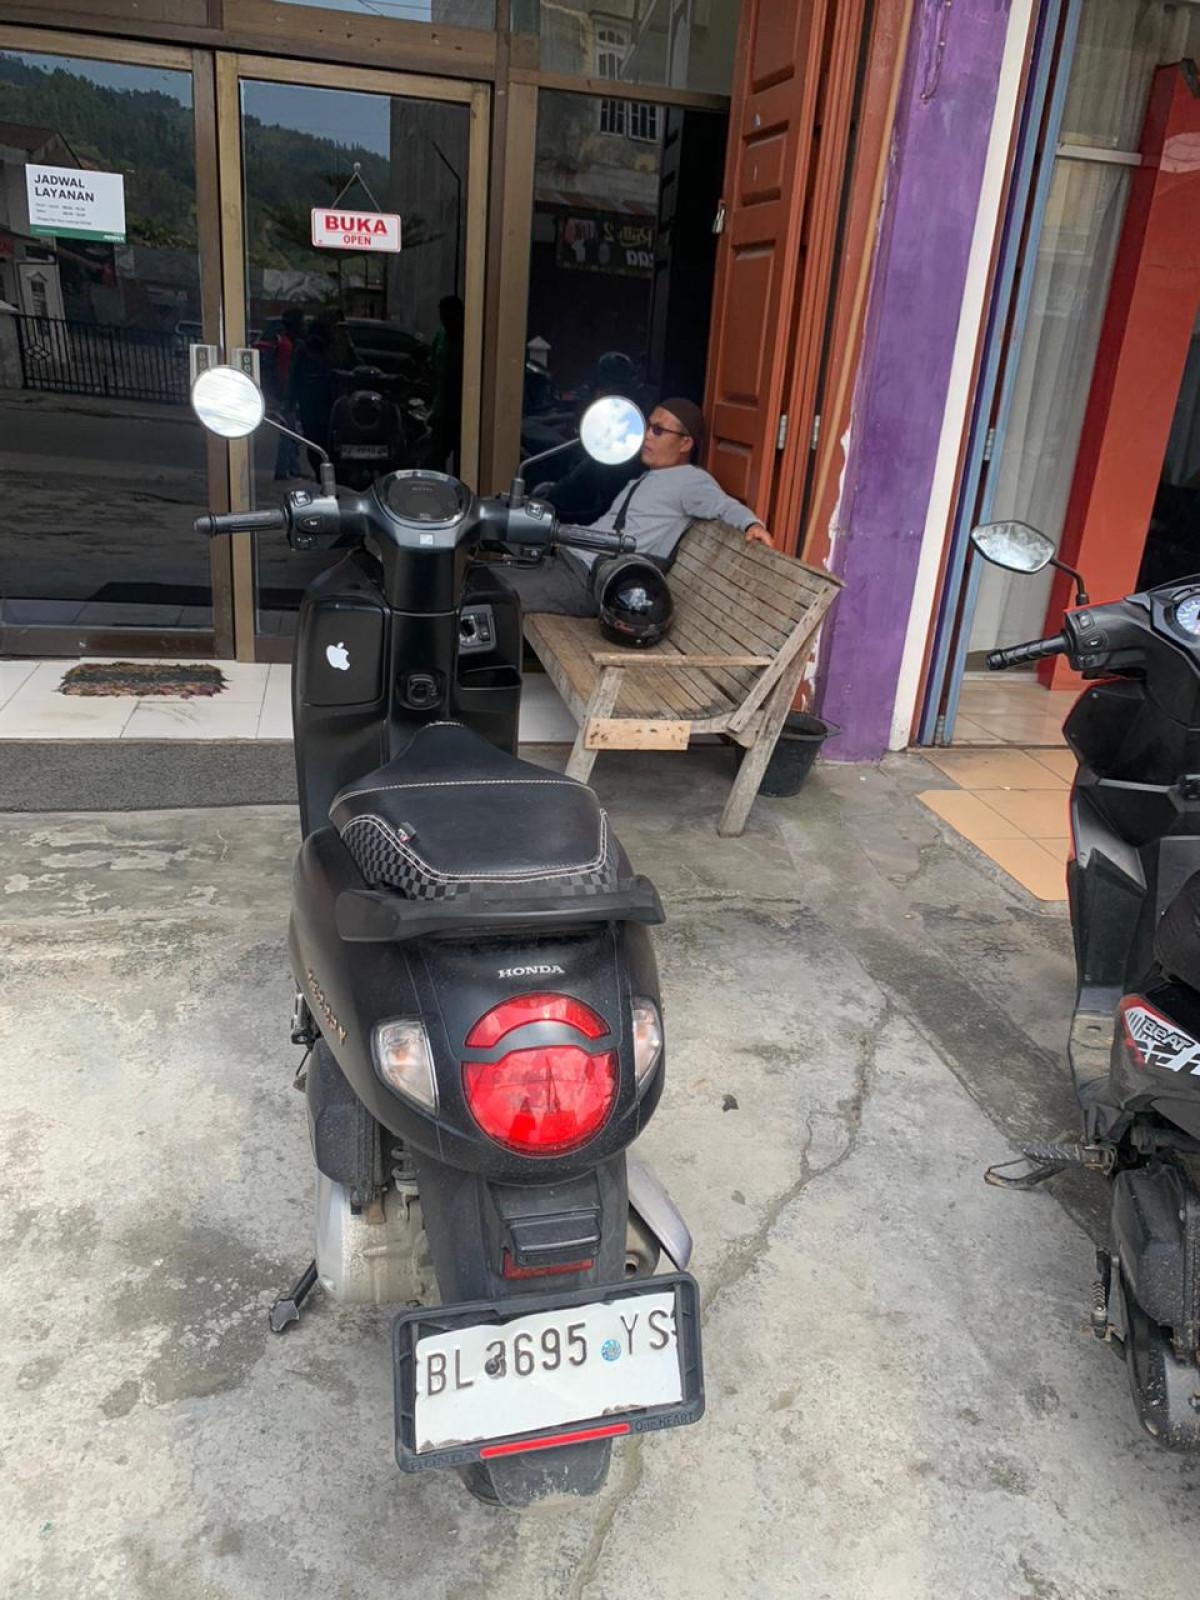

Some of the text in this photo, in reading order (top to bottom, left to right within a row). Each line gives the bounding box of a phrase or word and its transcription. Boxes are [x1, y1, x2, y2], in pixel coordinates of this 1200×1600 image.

[34, 174, 85, 188] JADWAL
[35, 187, 95, 202] LAYANAN
[325, 215, 387, 234] BUKA
[343, 235, 371, 245] OPEN
[498, 965, 565, 979] HONDA
[427, 1310, 669, 1396] BL 3695 YS
[410, 1451, 476, 1470] HONDA
